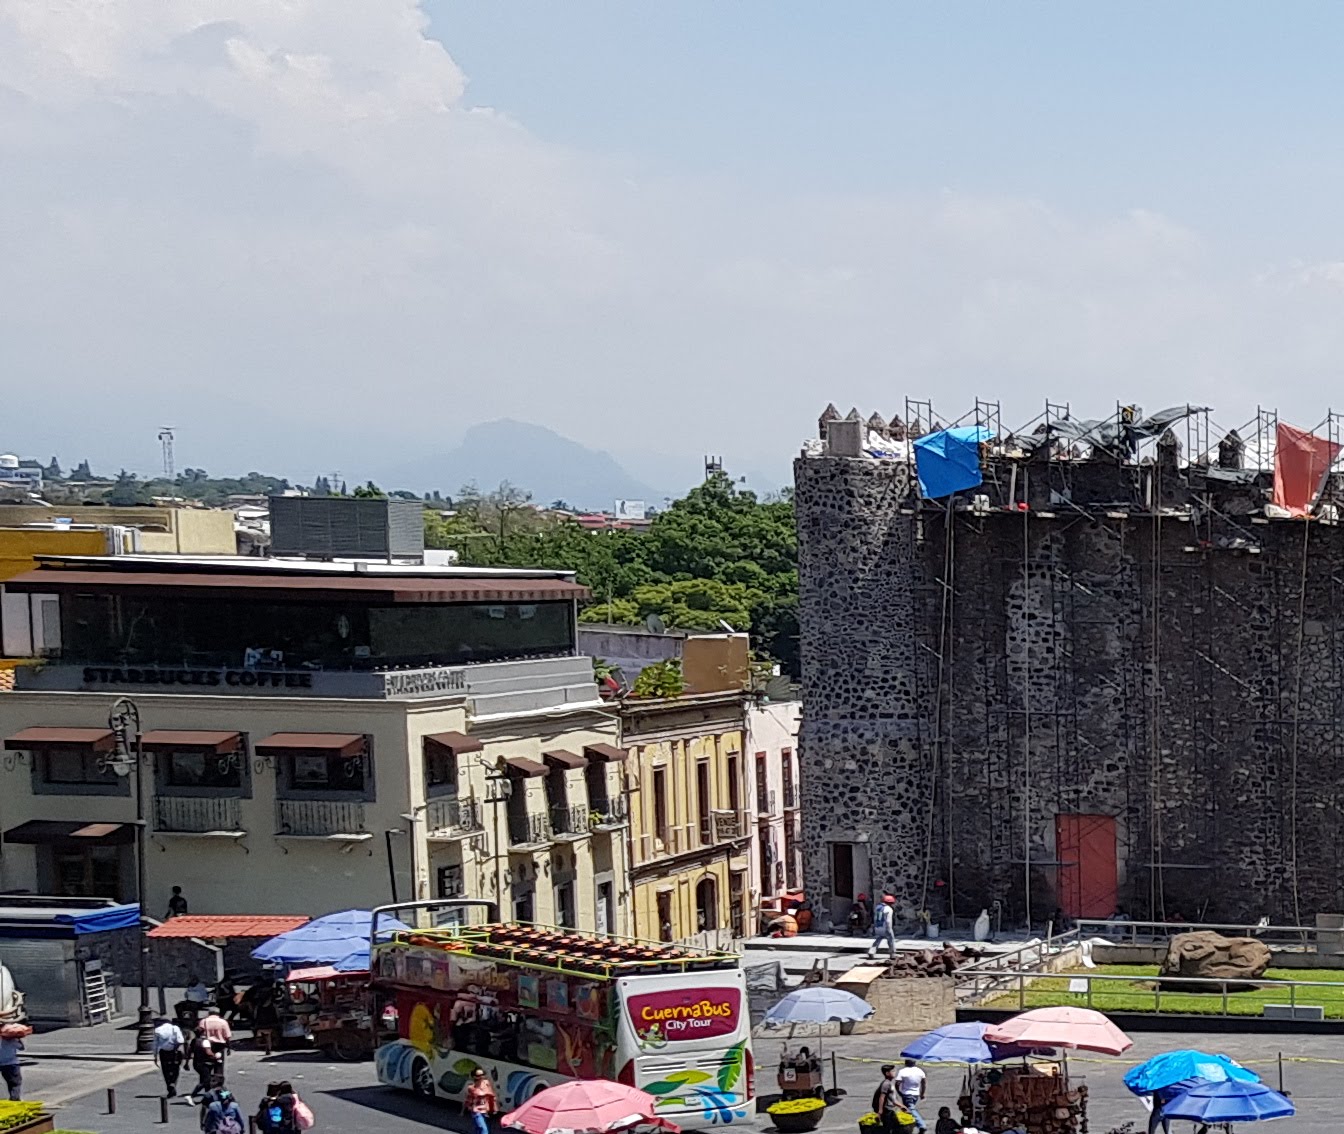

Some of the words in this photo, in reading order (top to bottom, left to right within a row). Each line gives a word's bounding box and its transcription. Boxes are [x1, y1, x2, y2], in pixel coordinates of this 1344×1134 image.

[224, 670, 312, 688] COFFEE
[665, 1020, 687, 1031] City
[689, 1018, 712, 1028] Tour
